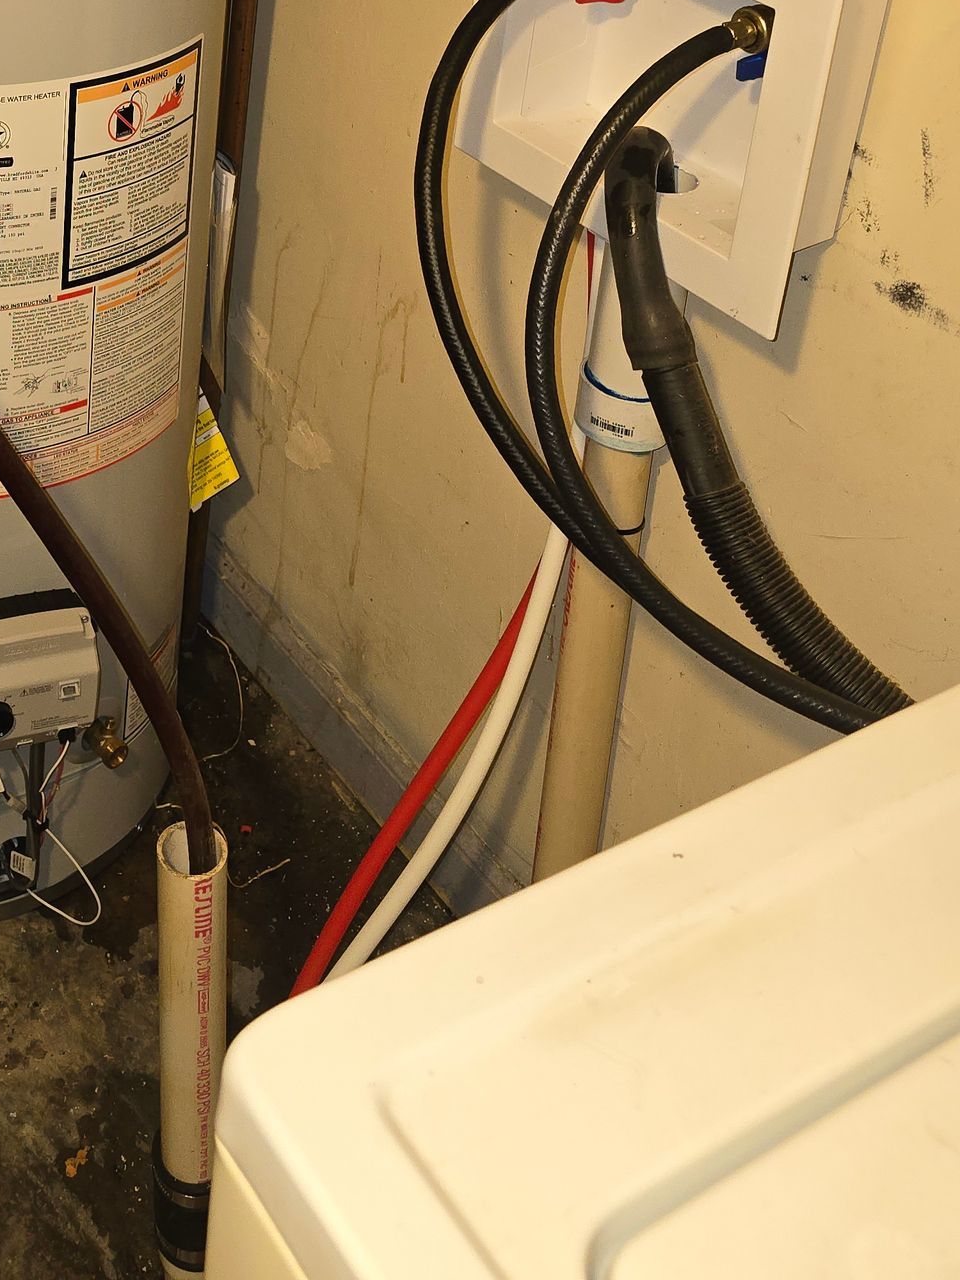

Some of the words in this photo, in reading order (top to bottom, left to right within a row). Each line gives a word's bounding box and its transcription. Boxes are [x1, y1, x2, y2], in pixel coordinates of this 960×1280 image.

[132, 69, 169, 89] WARNING
[7, 94, 32, 103] WATER
[34, 91, 61, 100] HEATER
[105, 153, 117, 161] FIRE
[117, 150, 128, 158] AND
[128, 140, 155, 155] EXPLOSION
[155, 132, 172, 144] HAZARD
[11, 295, 52, 308] INSTRUCTION
[23, 410, 55, 422] APPLIANCE
[197, 946, 211, 966] PVC
[197, 1048, 211, 1067] SCH
[197, 1068, 211, 1081] 40
[197, 1081, 211, 1100] 330
[197, 1101, 211, 1116] PSI
